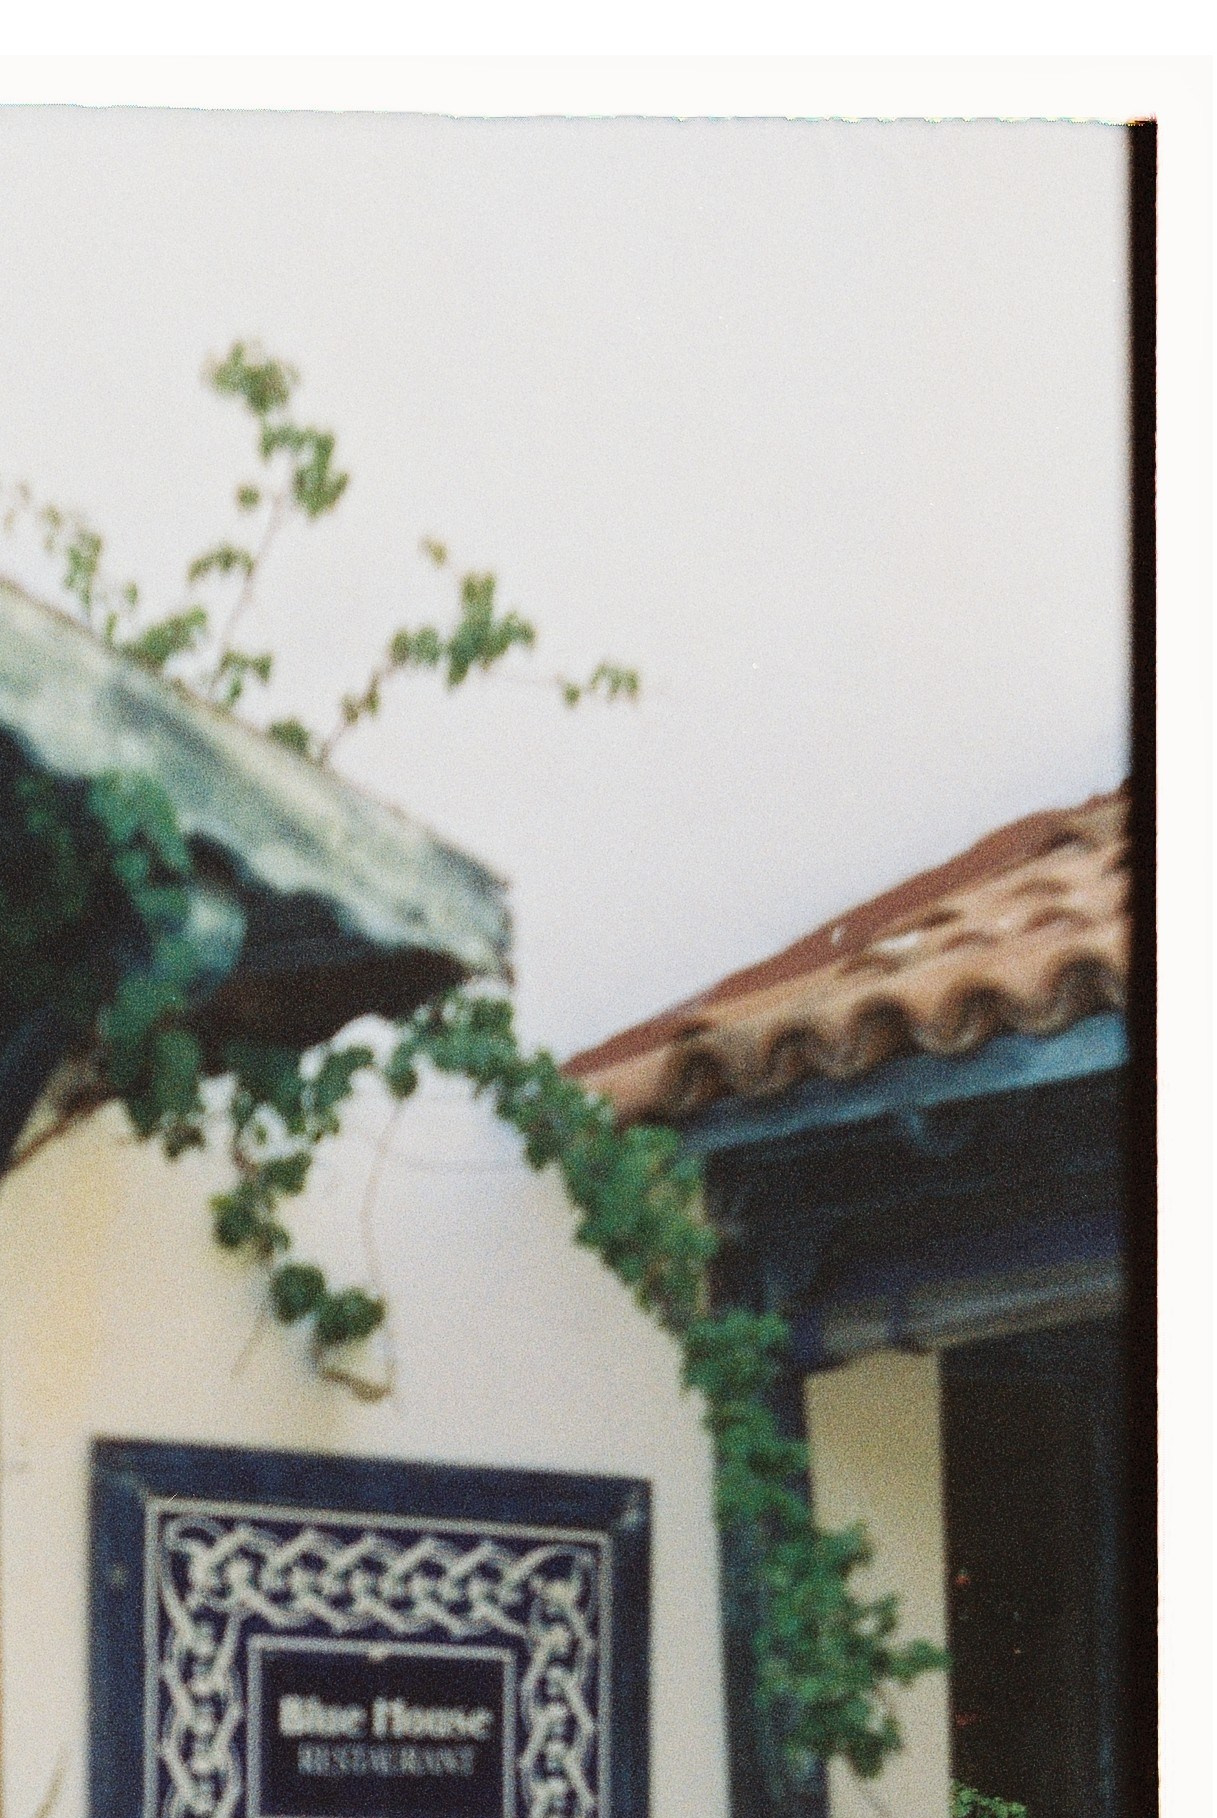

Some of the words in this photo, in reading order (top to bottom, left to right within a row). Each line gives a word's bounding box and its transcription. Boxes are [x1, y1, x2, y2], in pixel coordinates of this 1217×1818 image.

[279, 1694, 366, 1739] Blue
[371, 1696, 494, 1740] House
[296, 1743, 474, 1776] RESTAURANT
